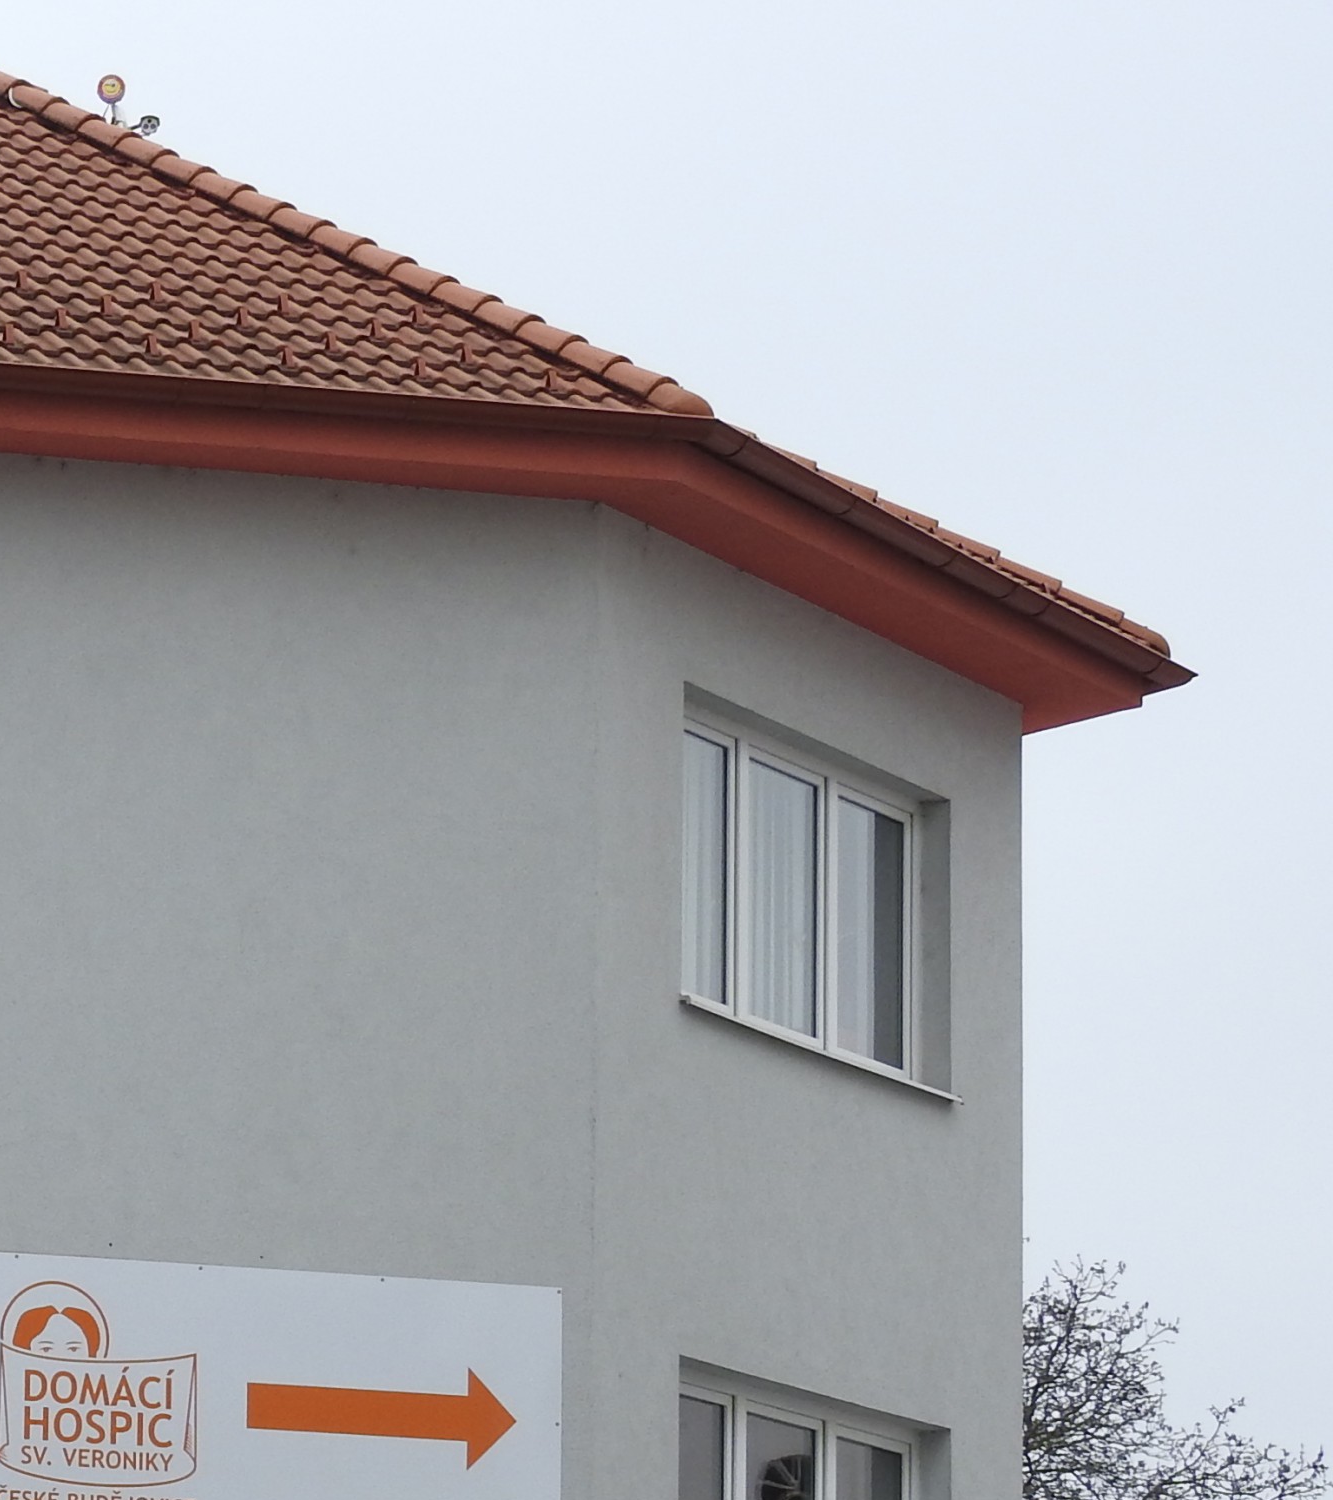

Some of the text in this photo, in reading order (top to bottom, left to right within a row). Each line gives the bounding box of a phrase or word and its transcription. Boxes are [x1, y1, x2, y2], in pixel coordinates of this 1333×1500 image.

[24, 1366, 175, 1410] DOMÁCÍ
[23, 1405, 173, 1448] HOSPIC
[21, 1445, 174, 1472] SV. VERONIKY
